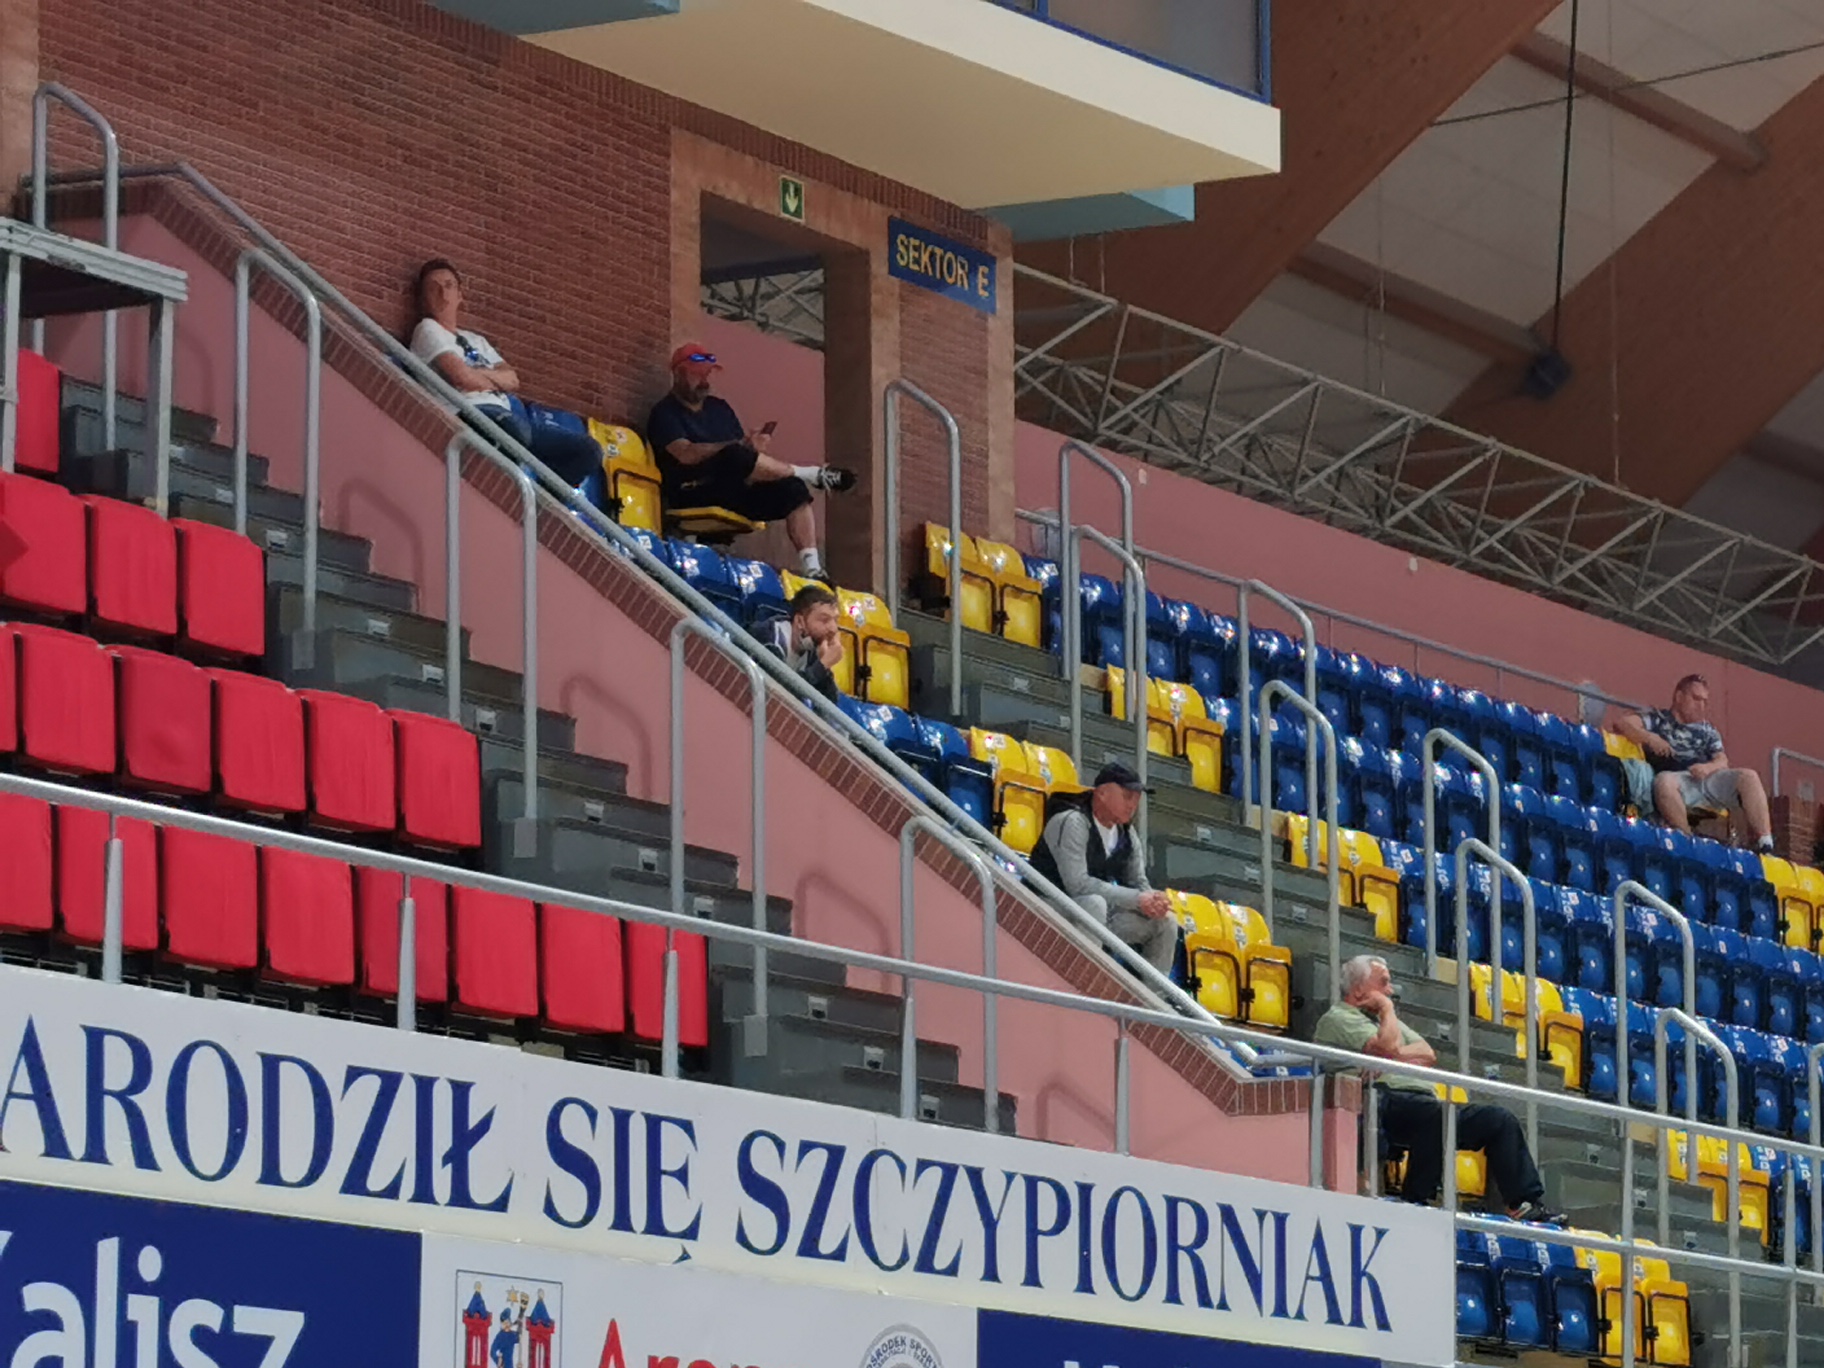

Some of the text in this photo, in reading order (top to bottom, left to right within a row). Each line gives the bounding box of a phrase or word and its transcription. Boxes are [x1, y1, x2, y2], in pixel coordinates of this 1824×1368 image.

[895, 234, 990, 298] SEKTOR E
[542, 1097, 703, 1264] SIĘ
[734, 1129, 1394, 1333] SZCZYPIORNIAK
